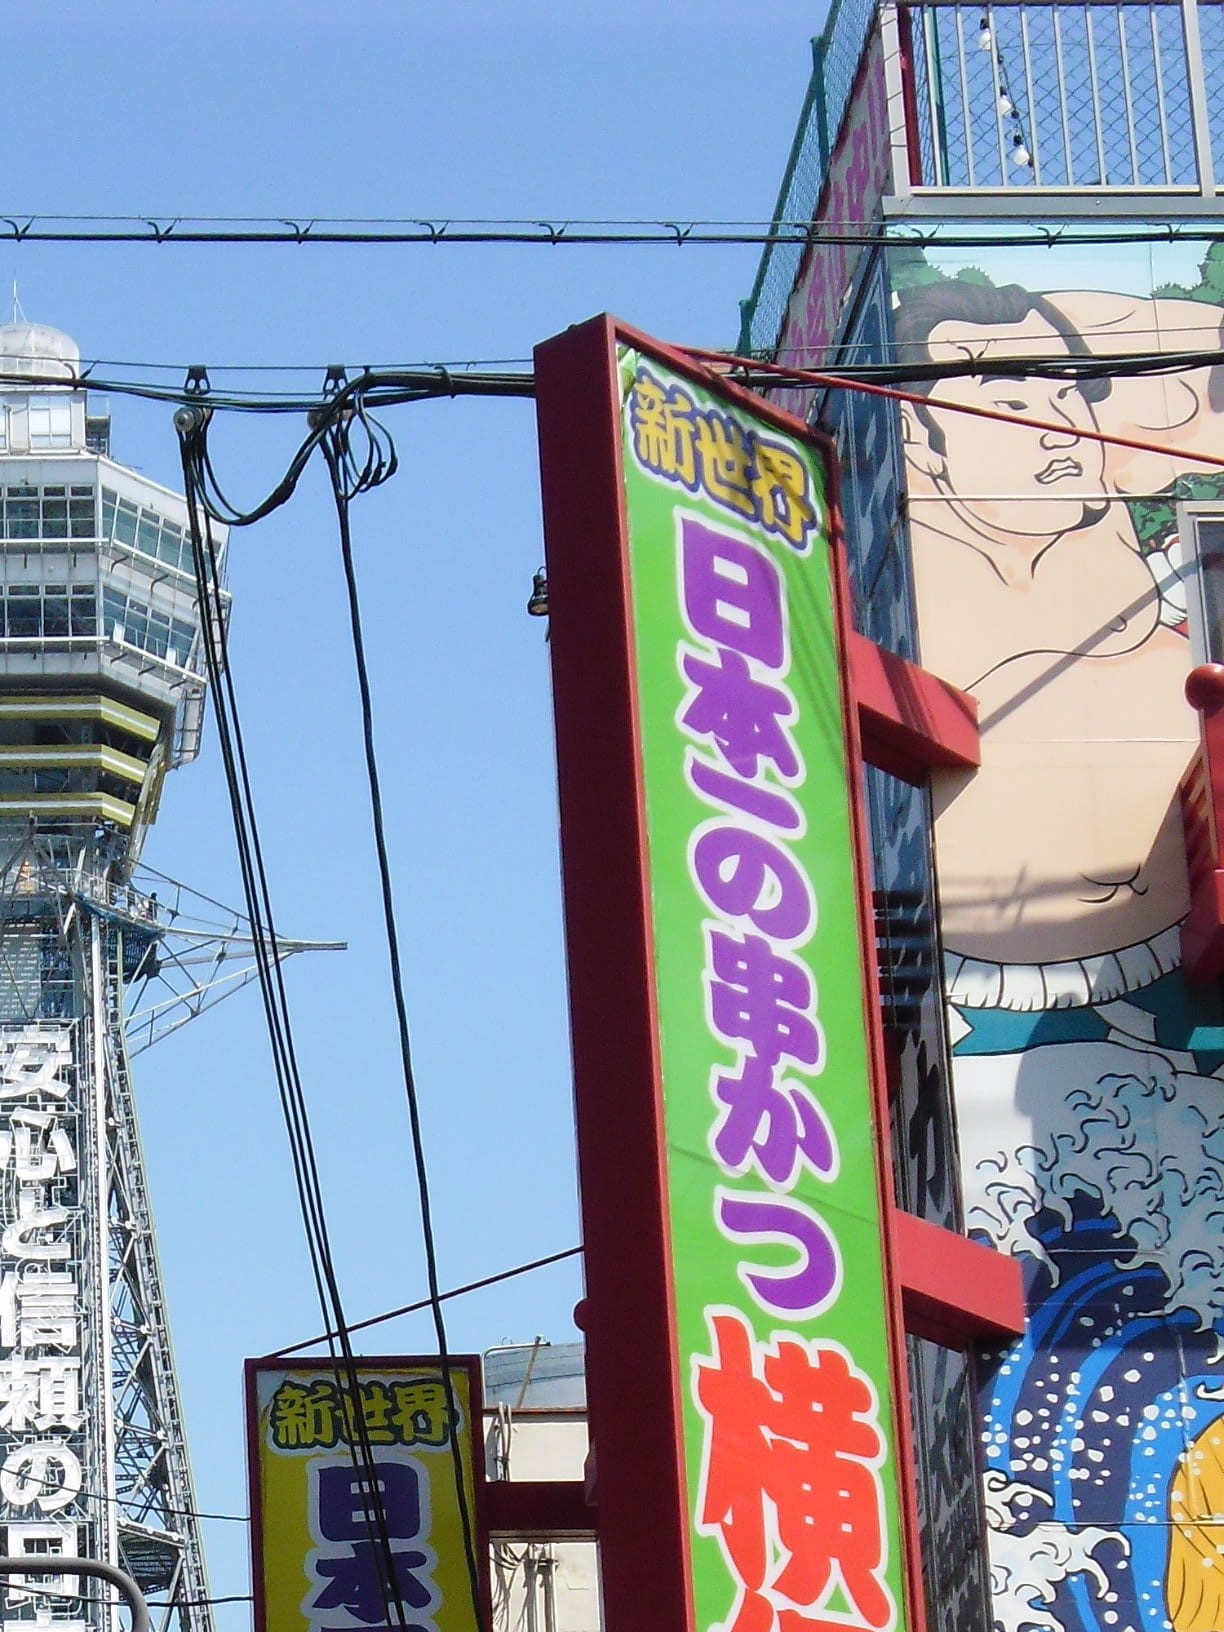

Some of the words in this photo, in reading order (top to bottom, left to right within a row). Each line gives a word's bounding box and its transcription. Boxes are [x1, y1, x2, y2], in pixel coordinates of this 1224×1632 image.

[631, 370, 817, 549] 新世界
[679, 512, 842, 1314] 日本一の串かつ
[275, 1380, 454, 1448] 新世界
